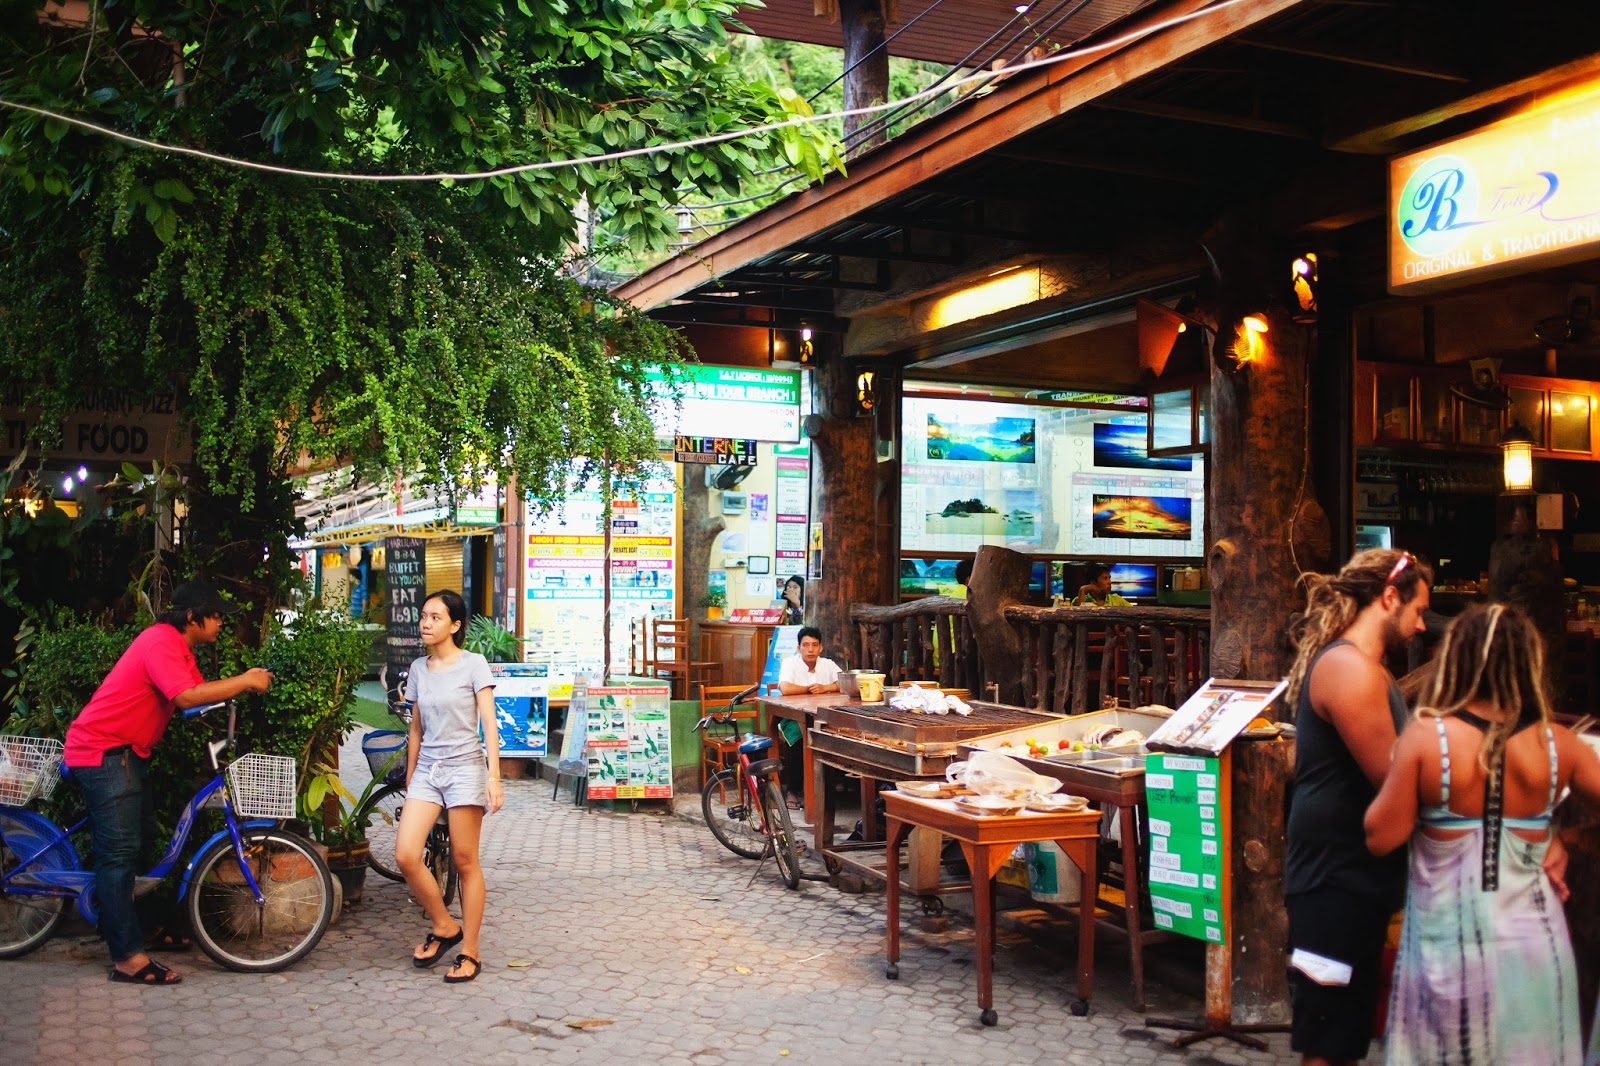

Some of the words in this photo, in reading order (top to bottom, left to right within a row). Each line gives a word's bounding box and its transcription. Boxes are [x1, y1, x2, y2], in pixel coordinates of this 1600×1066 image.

[1402, 249, 1476, 280] ORIGINAL
[1481, 243, 1496, 262] &
[77, 423, 149, 455] FOOD
[675, 436, 756, 455] INTERNET
[718, 454, 757, 466] CAFE
[388, 561, 420, 574] BUFFET
[612, 566, 637, 574] DIVING
[399, 575, 412, 587] YOU
[392, 587, 417, 605] EAT
